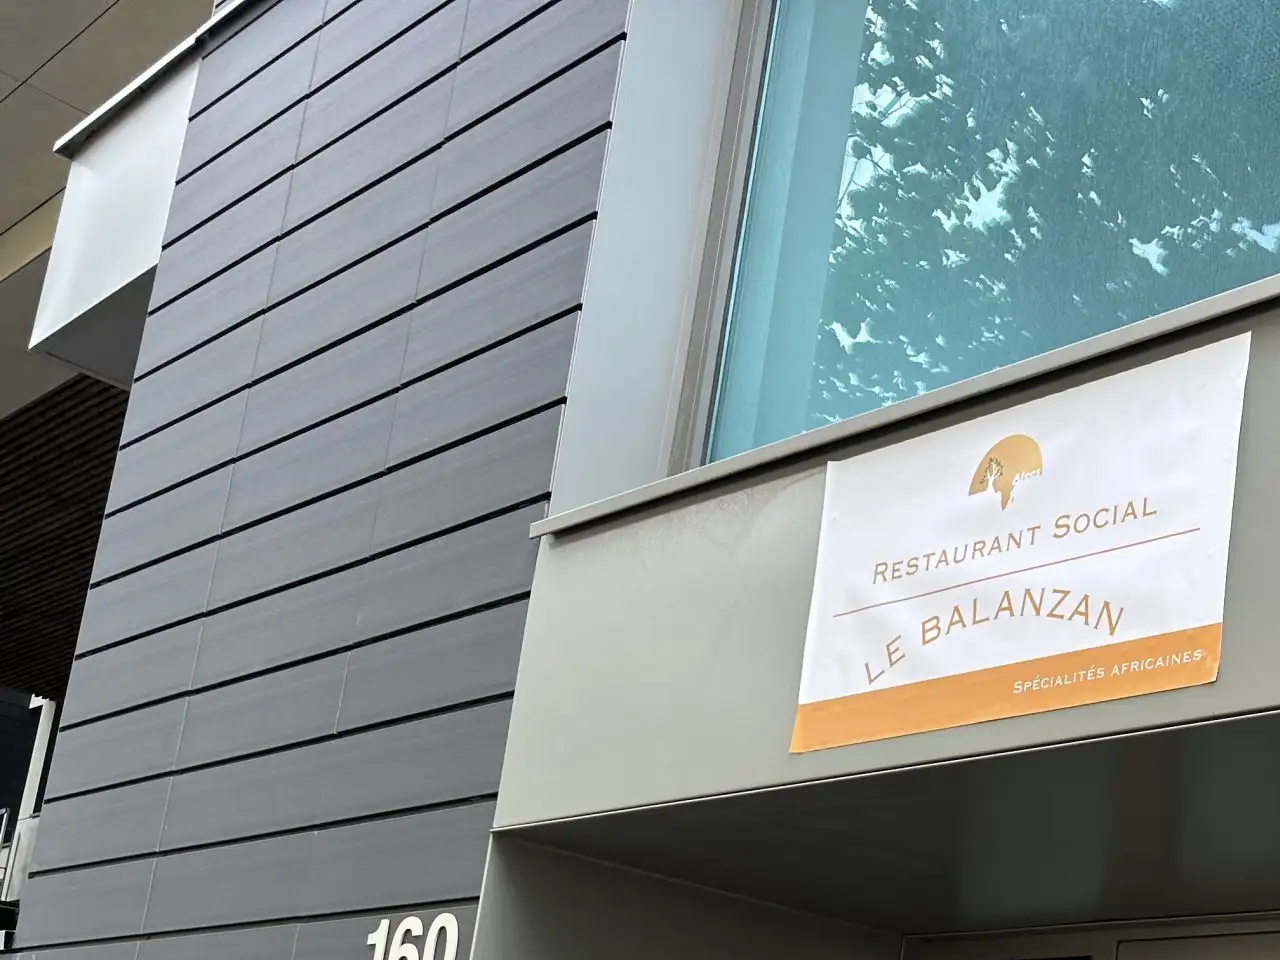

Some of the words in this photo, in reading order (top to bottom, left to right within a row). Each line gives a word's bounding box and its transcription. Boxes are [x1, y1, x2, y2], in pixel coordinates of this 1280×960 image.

[872, 526, 1041, 584] RESTAURANT
[1052, 497, 1157, 539] SOCIAL
[865, 635, 906, 685] LE
[921, 587, 1124, 646] BALANZAN
[1013, 664, 1105, 694] SPÉCIALITÉS
[1110, 649, 1203, 677] AFRICAINES
